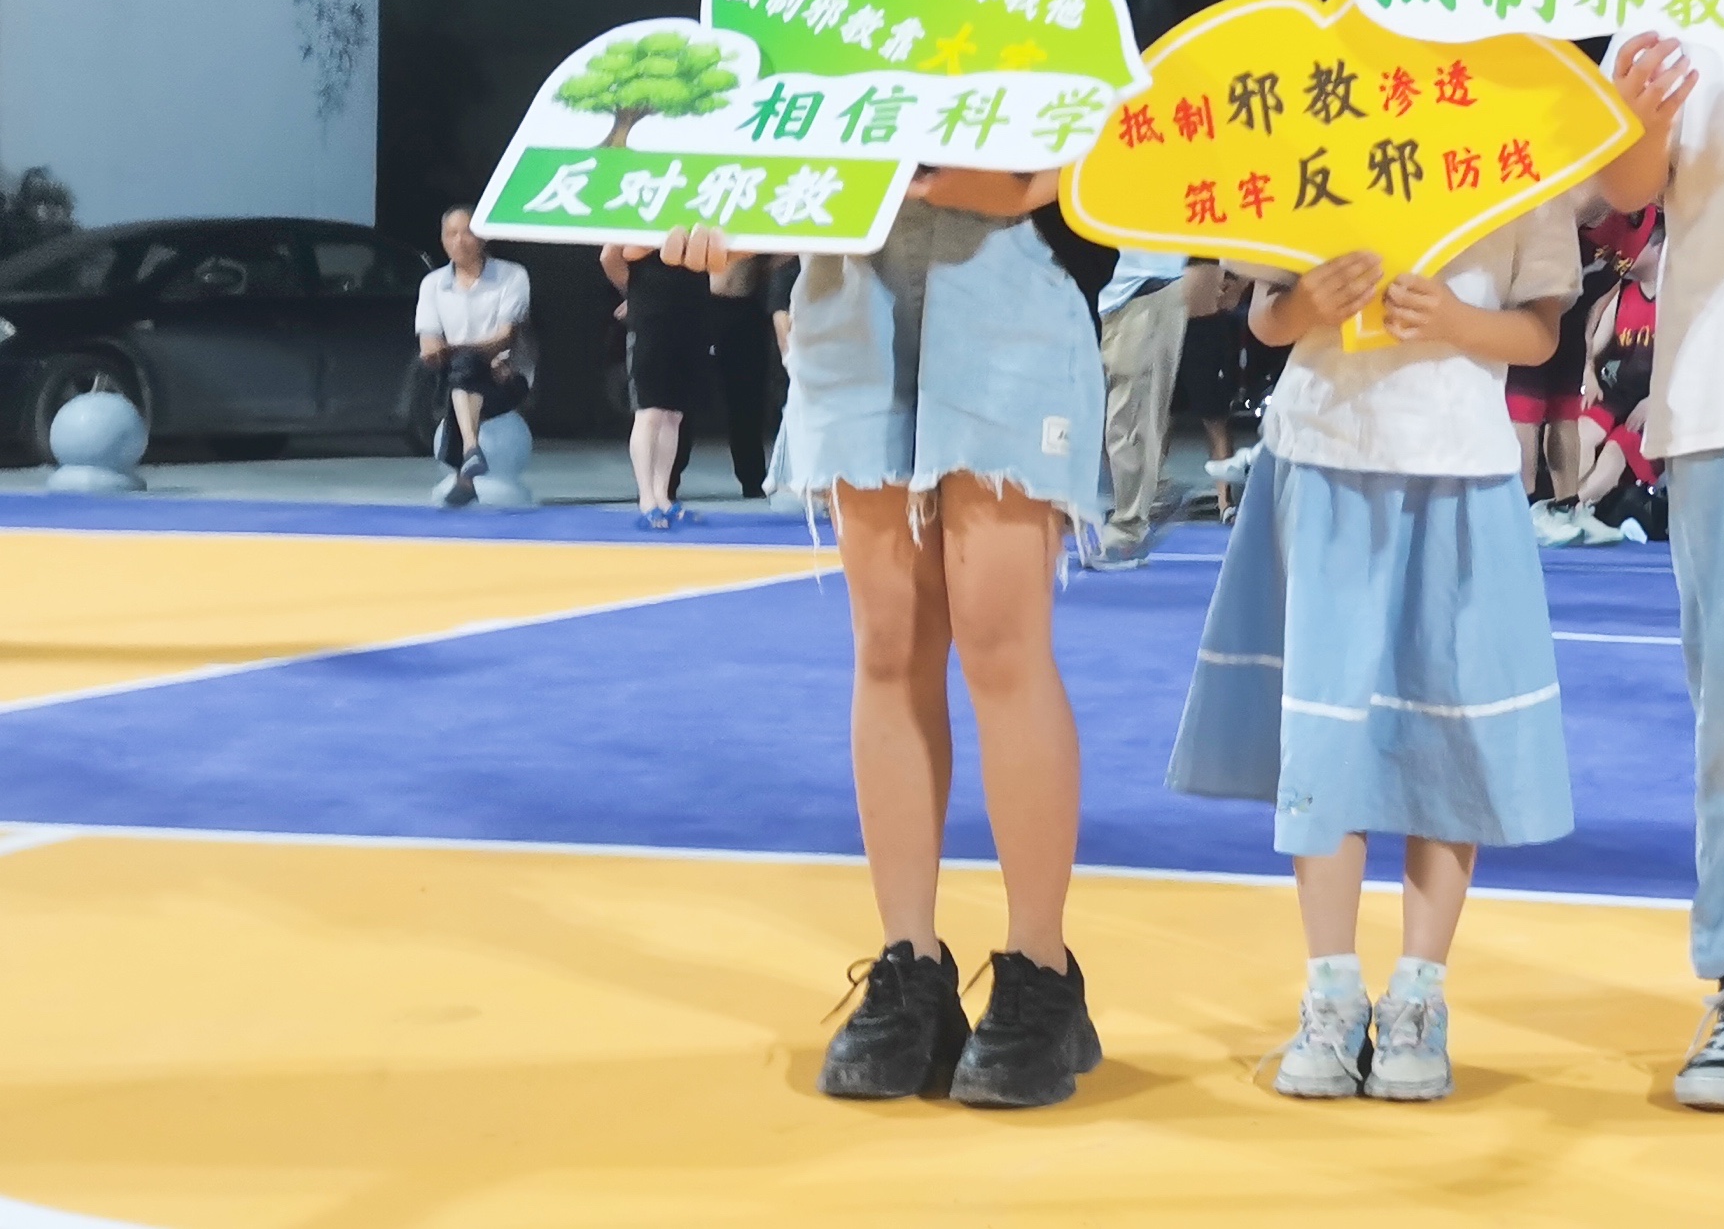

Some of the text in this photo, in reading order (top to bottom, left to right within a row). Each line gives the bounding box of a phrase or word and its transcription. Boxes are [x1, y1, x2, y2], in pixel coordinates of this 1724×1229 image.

[735, 81, 1106, 153] 相信科学
[1118, 58, 1478, 150] 抵制邪教渗透
[523, 157, 845, 226] 反对邪教
[1183, 137, 1541, 225] 筑牢反邪防线
